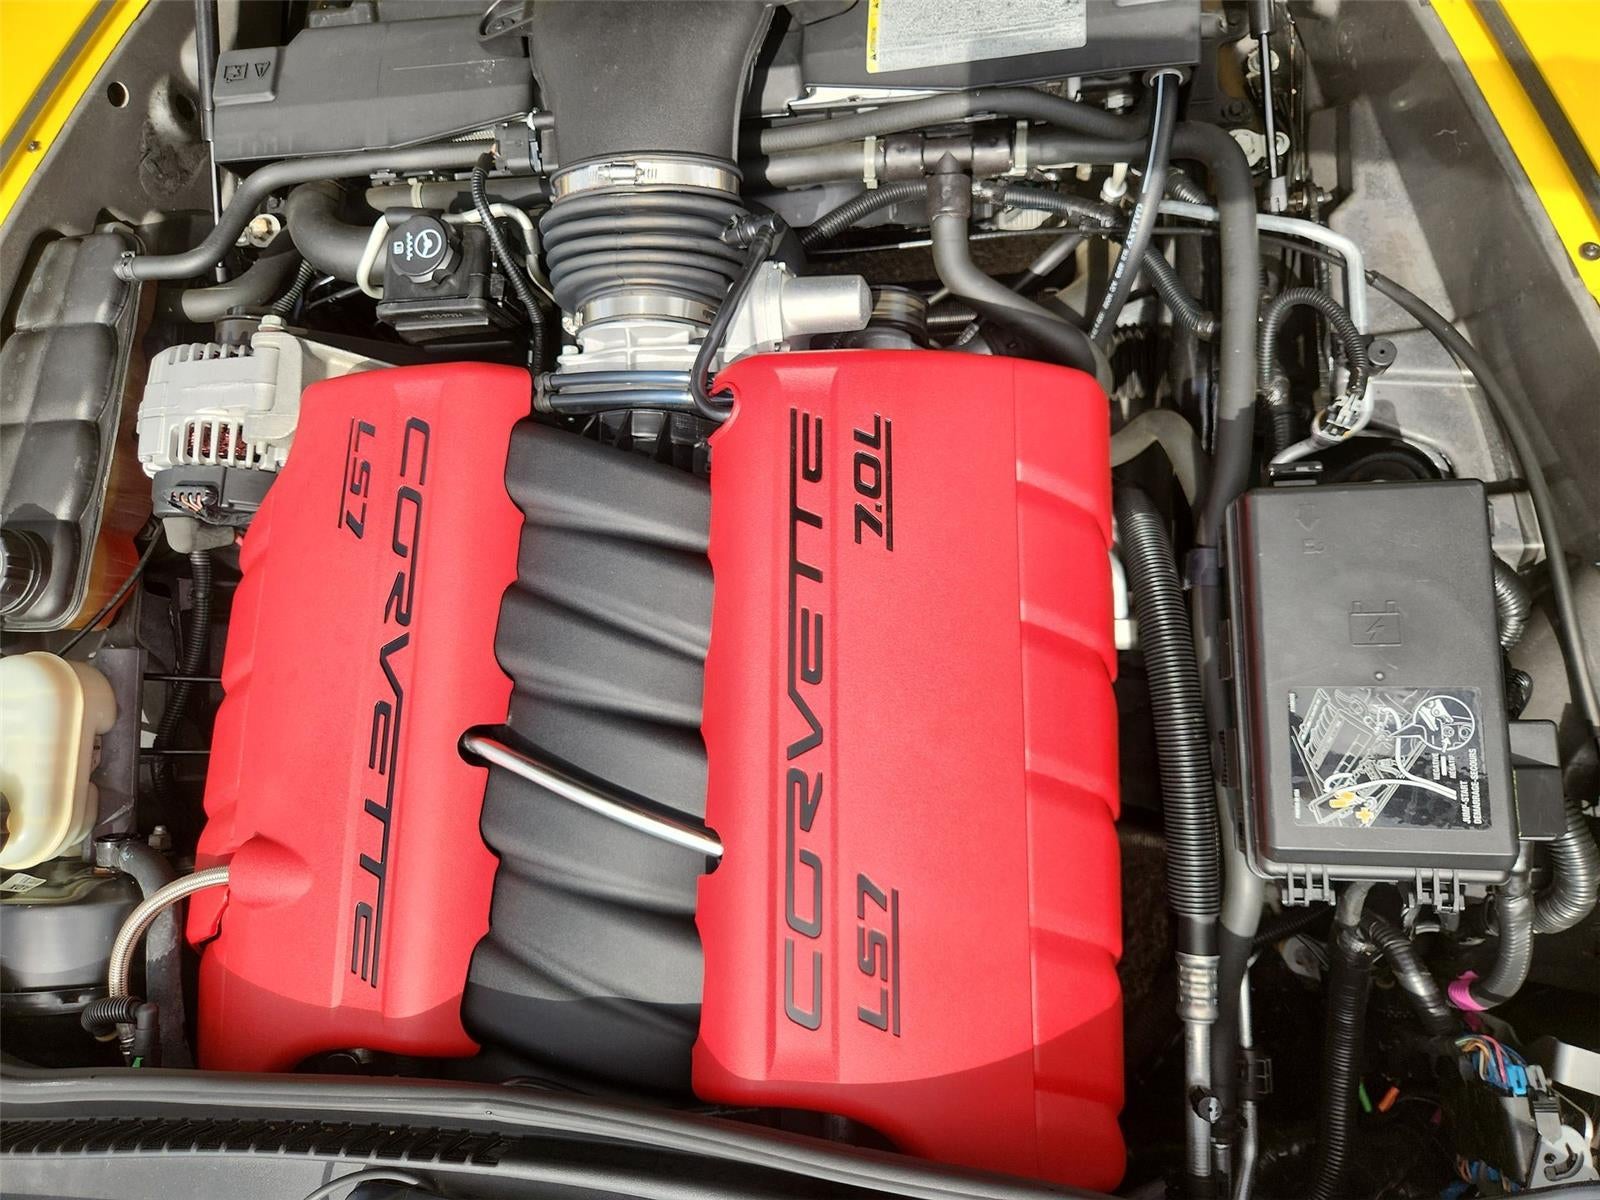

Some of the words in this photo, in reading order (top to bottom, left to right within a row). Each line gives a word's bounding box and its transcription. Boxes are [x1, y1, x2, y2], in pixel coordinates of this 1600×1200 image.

[346, 419, 376, 540] LS7
[853, 412, 883, 545] 7.0L
[350, 416, 431, 989] CORVETTE
[784, 406, 823, 1032] CORVETTE
[1460, 780, 1472, 824] JUMP-START
[857, 871, 888, 1032] LS7
